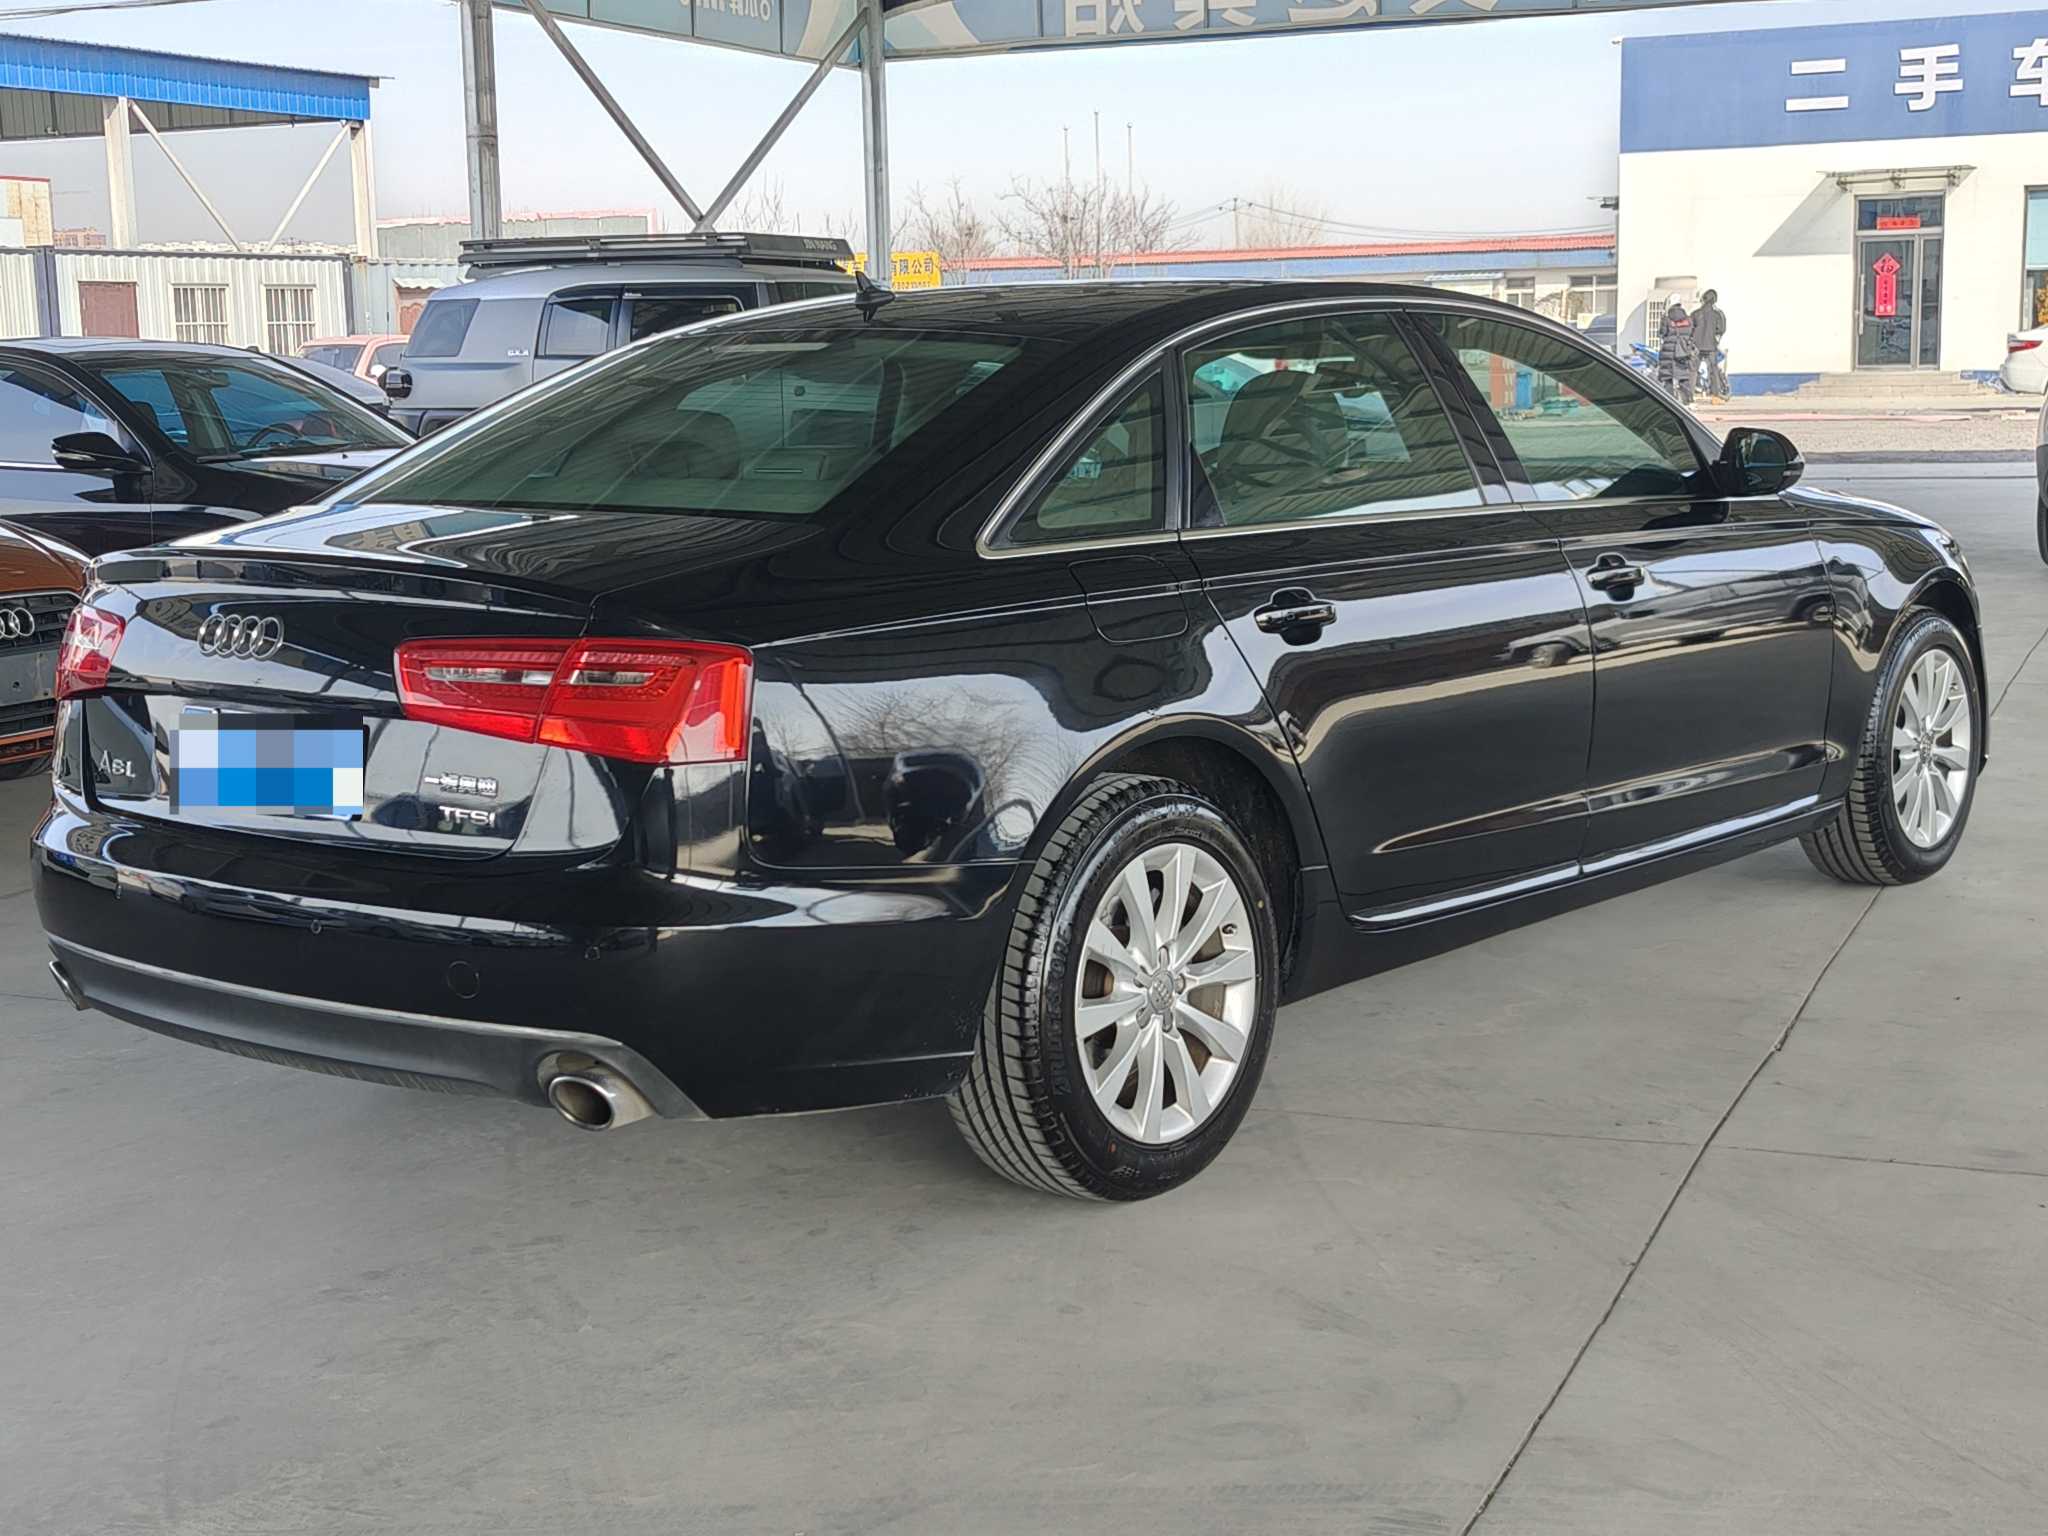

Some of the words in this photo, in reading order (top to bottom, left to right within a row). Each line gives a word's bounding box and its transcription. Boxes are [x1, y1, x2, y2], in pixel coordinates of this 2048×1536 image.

[1784, 38, 2048, 113] 二手车
[98, 750, 136, 778] A6L
[438, 805, 496, 828] TFSI
